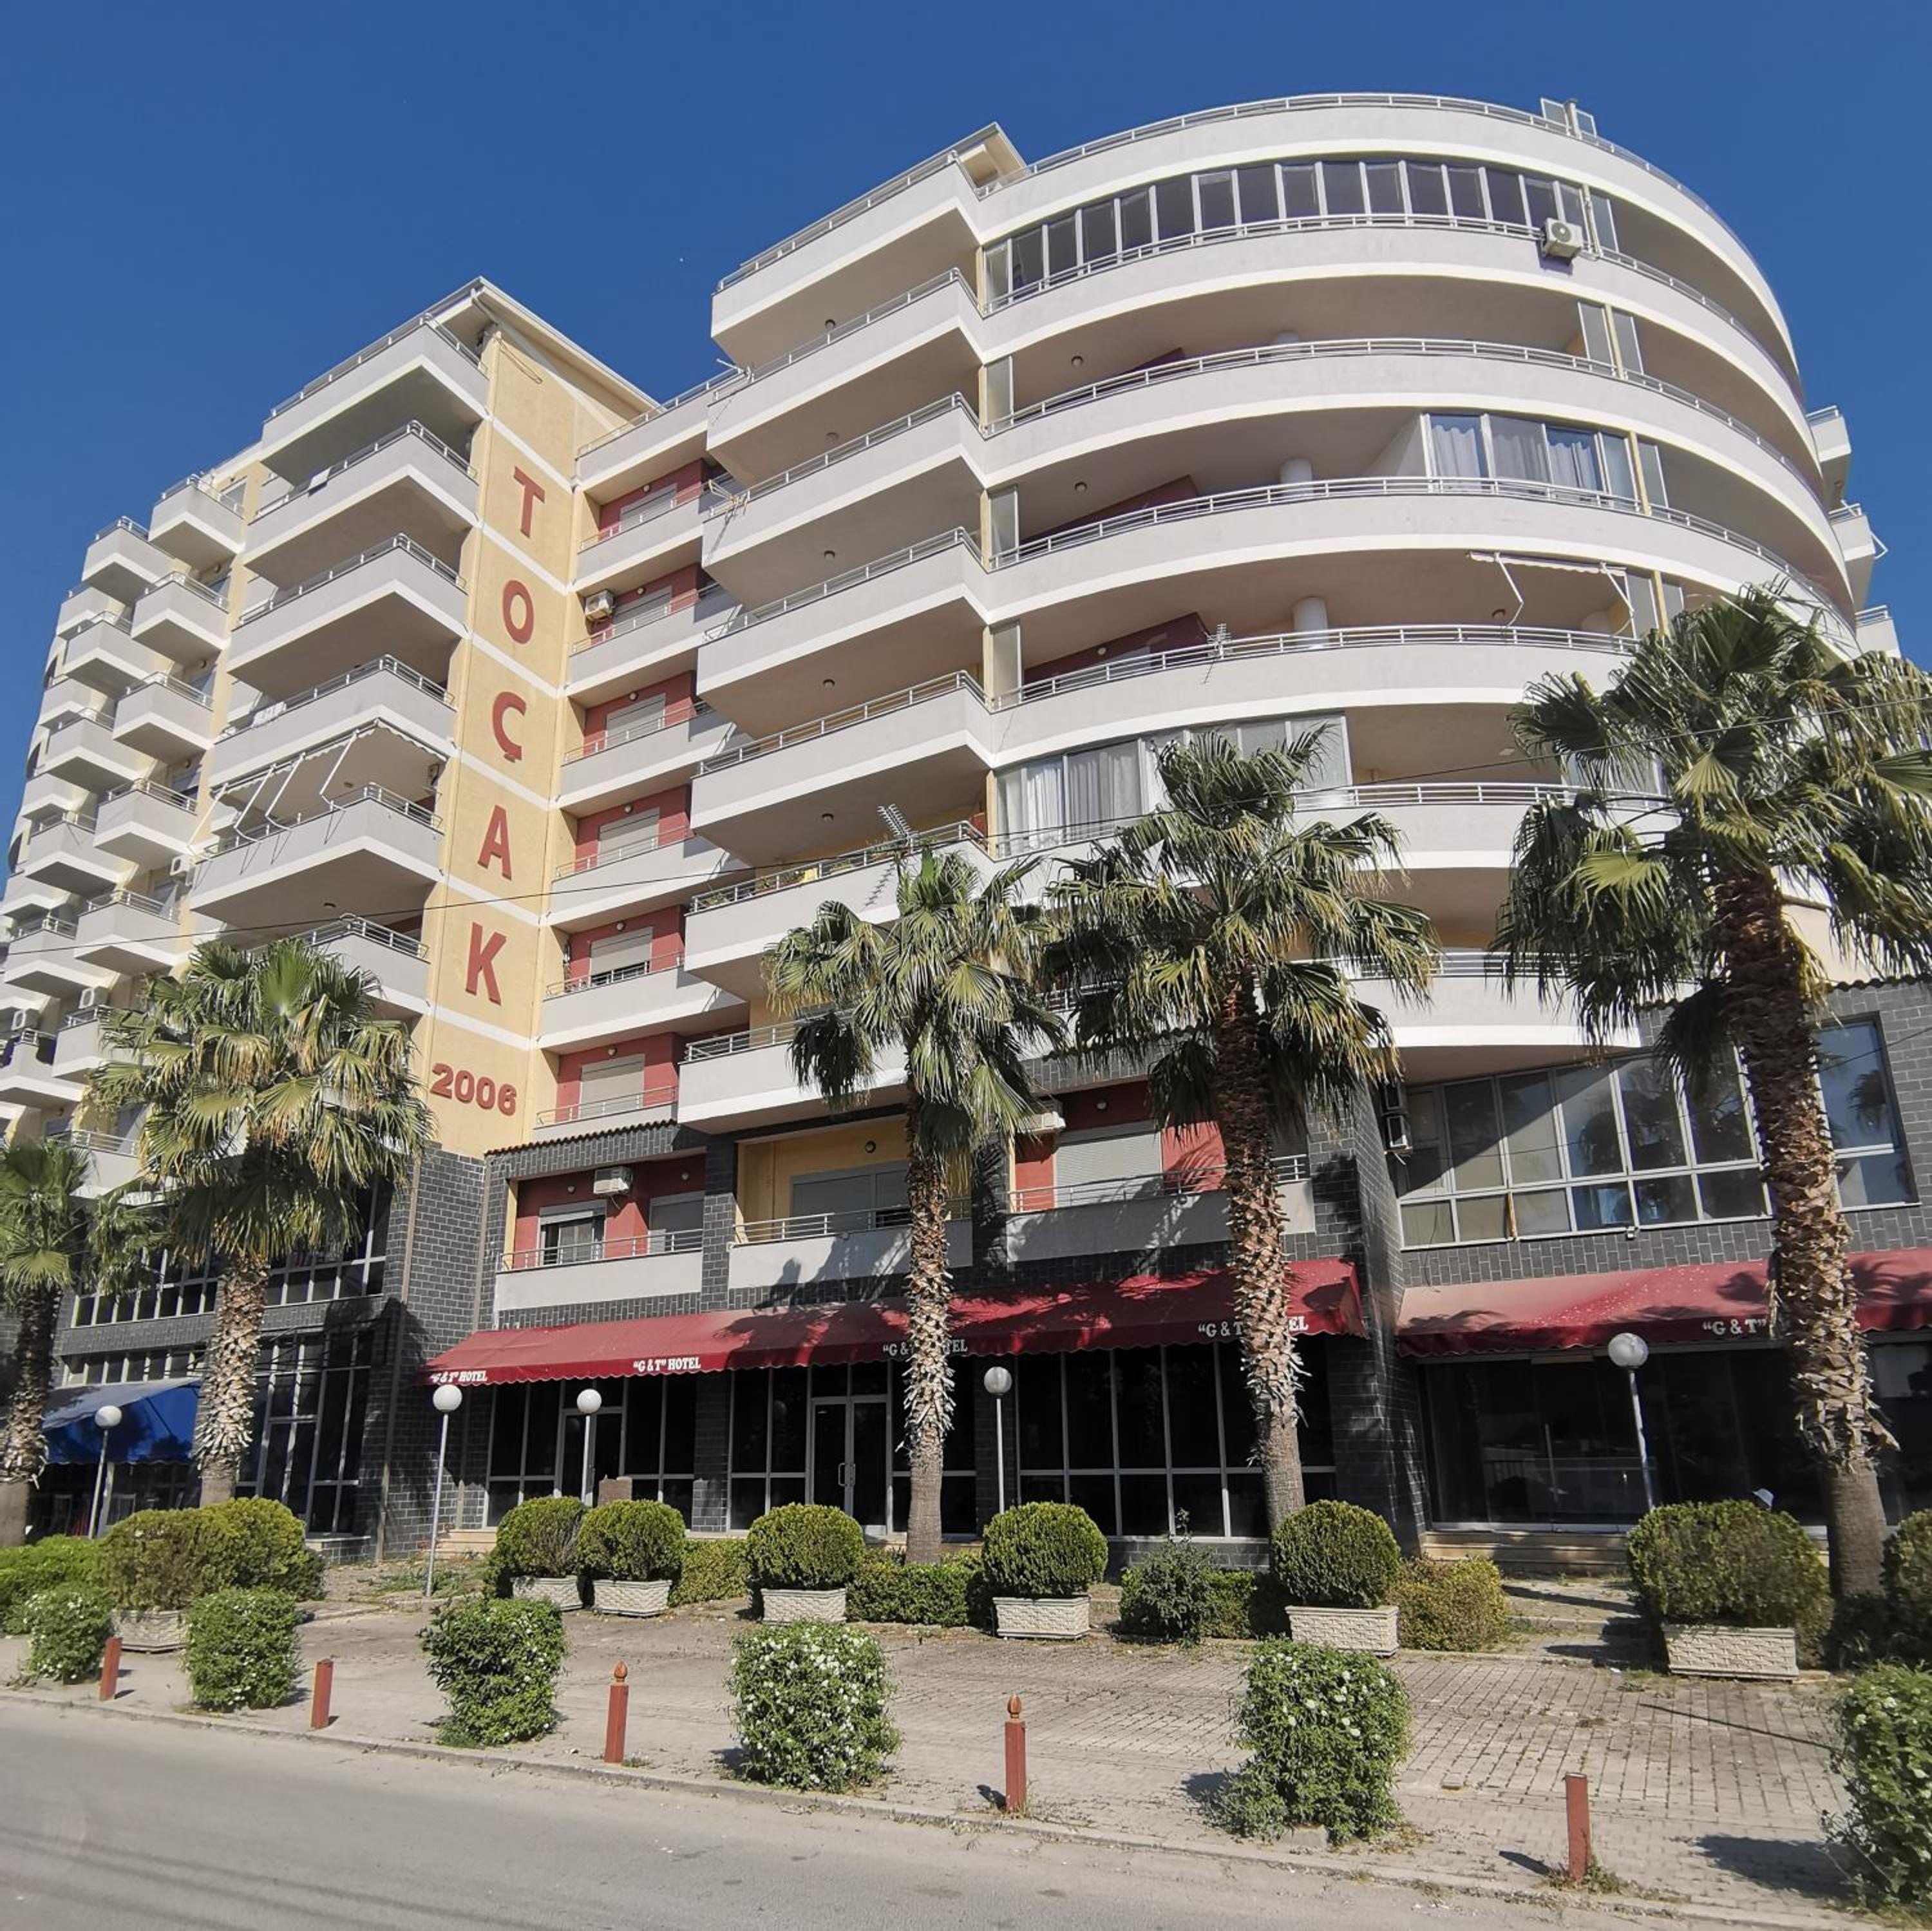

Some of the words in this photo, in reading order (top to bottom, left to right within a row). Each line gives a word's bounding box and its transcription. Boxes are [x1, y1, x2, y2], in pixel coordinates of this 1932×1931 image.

[430, 1062, 517, 1116] 2006
[1220, 1321, 1231, 1336] &
[1730, 1318, 1743, 1334] &
[900, 1342, 909, 1355] &
[647, 1358, 654, 1371] &
[668, 1356, 701, 1371] HOTEL
[458, 1370, 488, 1382] HOTEL
